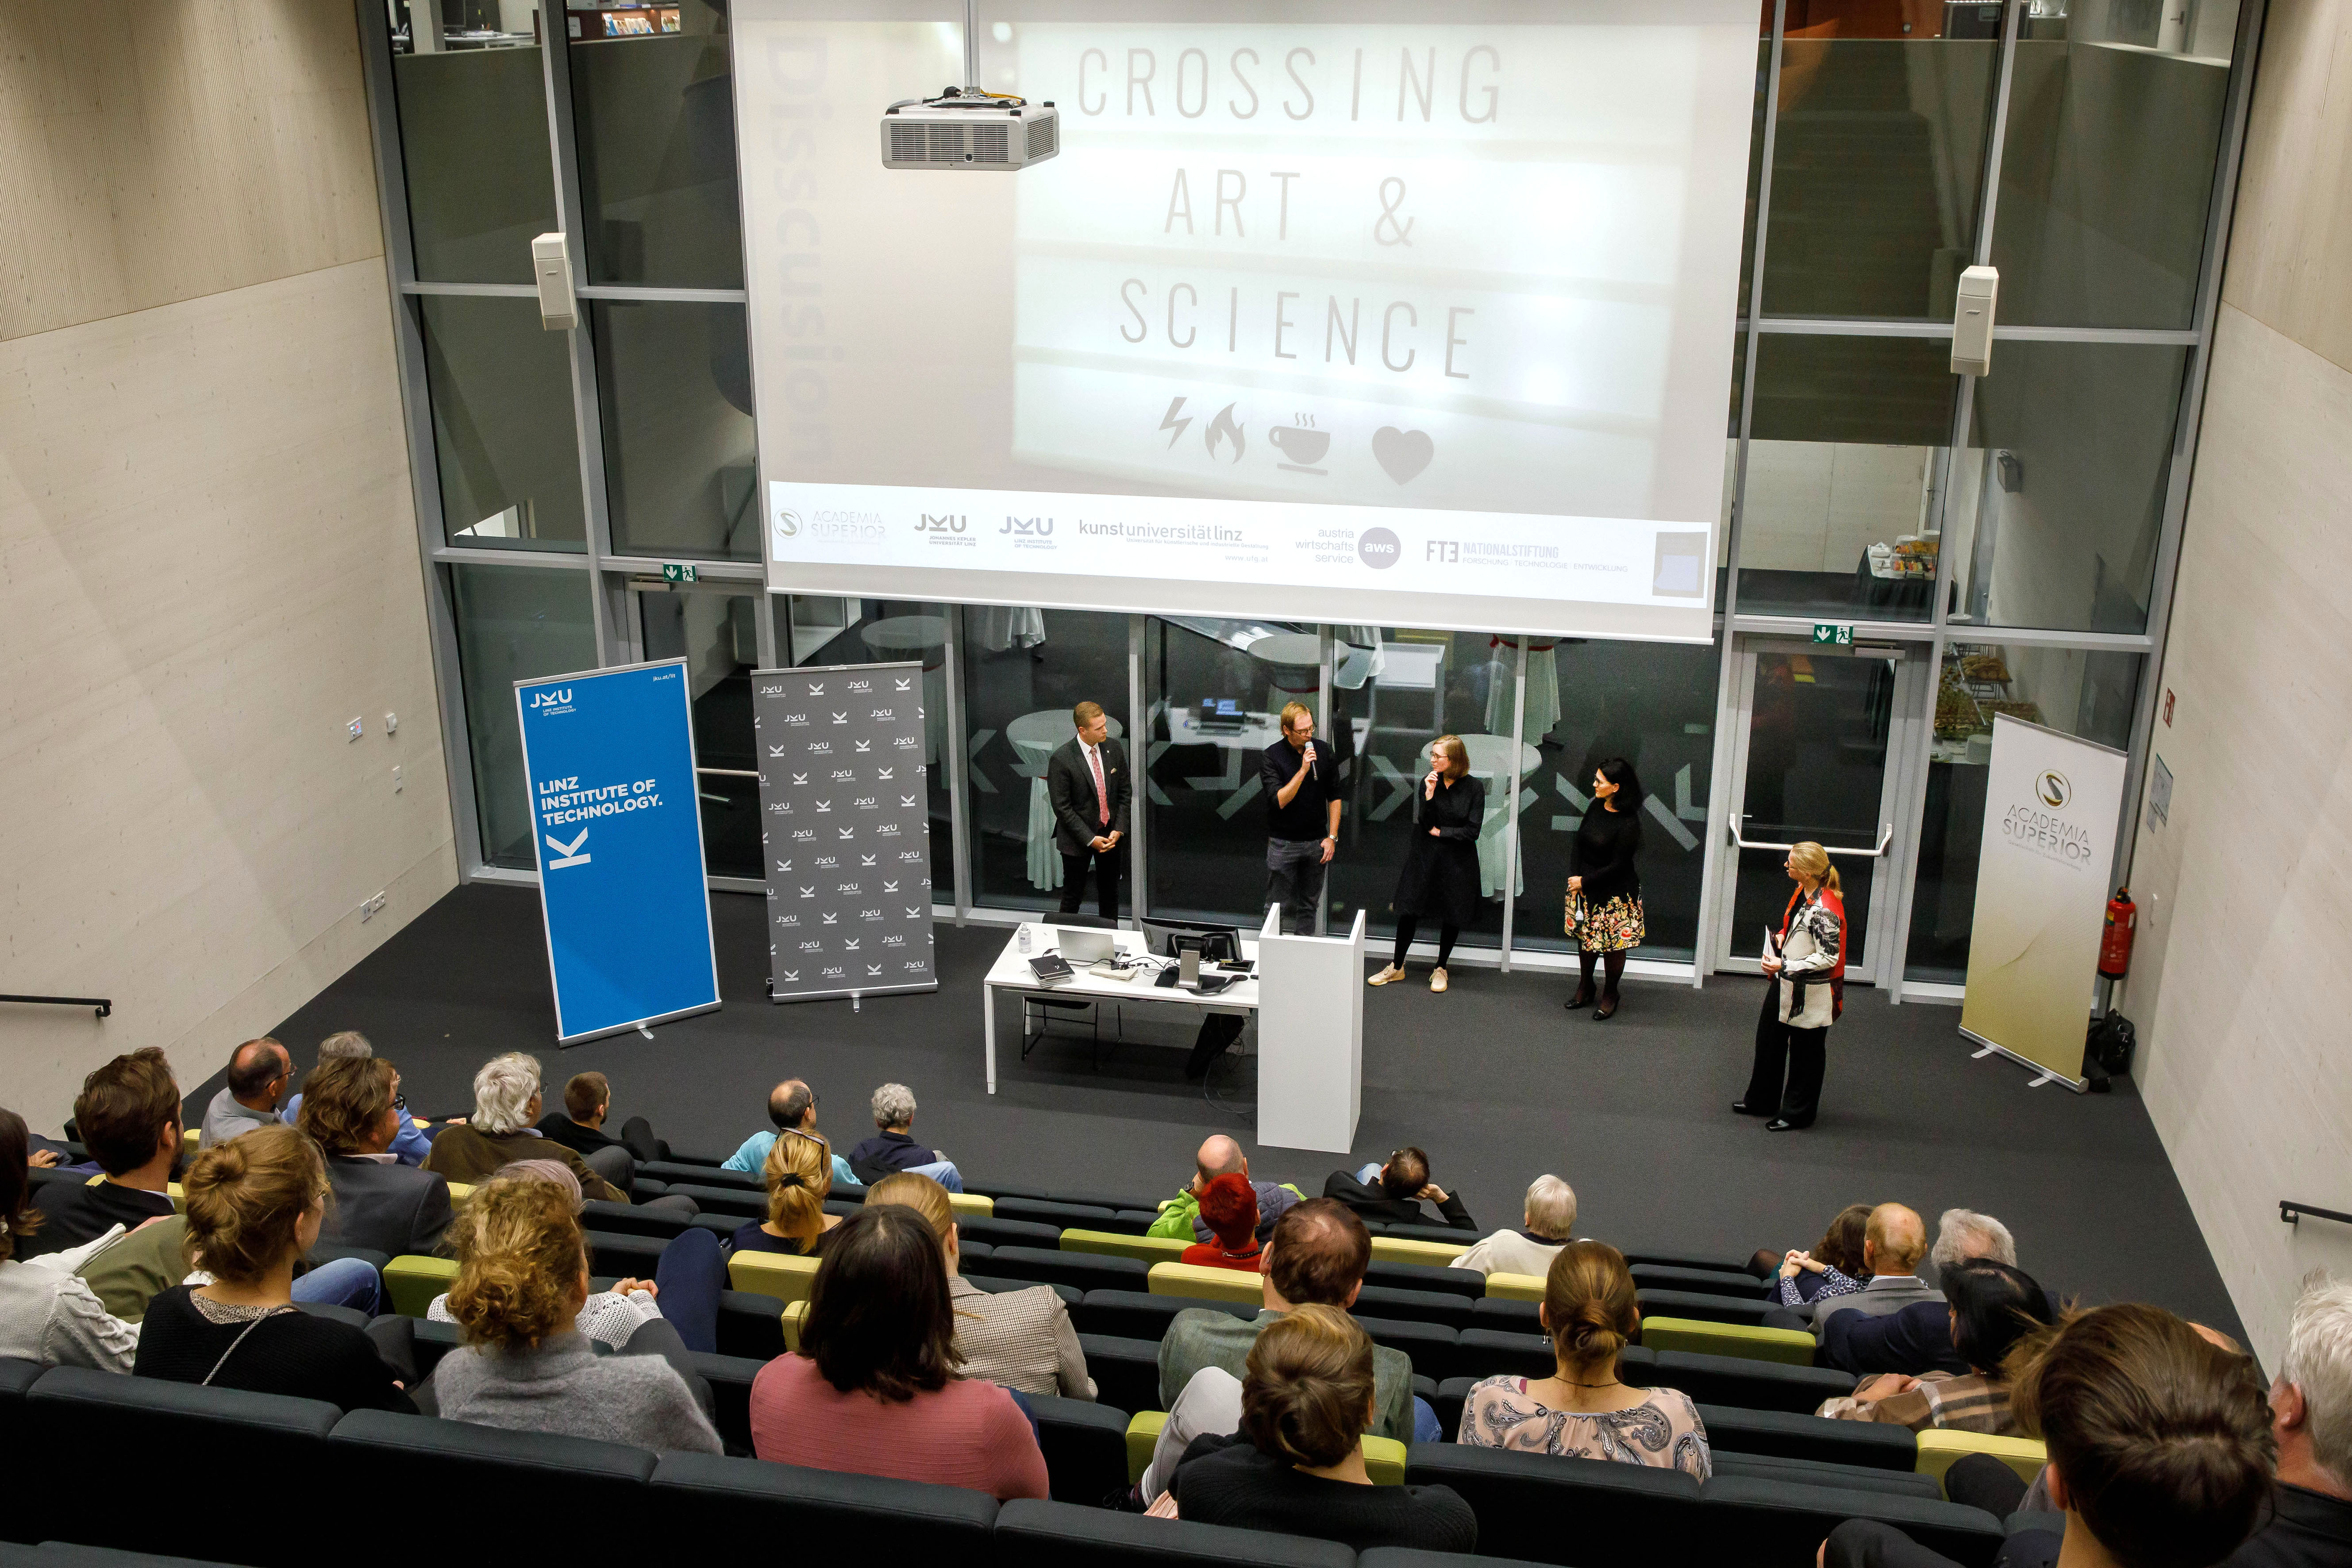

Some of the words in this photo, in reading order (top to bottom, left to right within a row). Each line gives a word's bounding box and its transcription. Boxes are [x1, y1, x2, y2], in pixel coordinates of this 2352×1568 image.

[1078, 44, 1501, 123] CROSSING
[1164, 168, 1301, 240] ART
[1373, 176, 1415, 247] &
[1120, 278, 1475, 379] SCIENCE
[813, 511, 882, 524] ACADEMIA
[811, 524, 885, 539] SUPERIOR
[1318, 528, 1354, 539] austria
[1295, 539, 1354, 551] wirtschafts
[1364, 543, 1394, 554] aws
[1463, 542, 1559, 559] NATIONALSTIFTUNG
[1315, 553, 1354, 563] service
[1463, 557, 1509, 566] FORSCHUNG
[1514, 559, 1568, 569] TECHNOLOGIE
[1573, 562, 1628, 572] ENTWICKLUNG
[530, 689, 572, 708] JKU
[539, 776, 579, 795] LINZ
[541, 784, 629, 810] INSTITUTE
[632, 779, 655, 794] OF
[543, 794, 663, 826] TECHNOLOGY.
[2007, 804, 2089, 845] ACADEMIA
[2002, 818, 2091, 865] SUPERIOR
